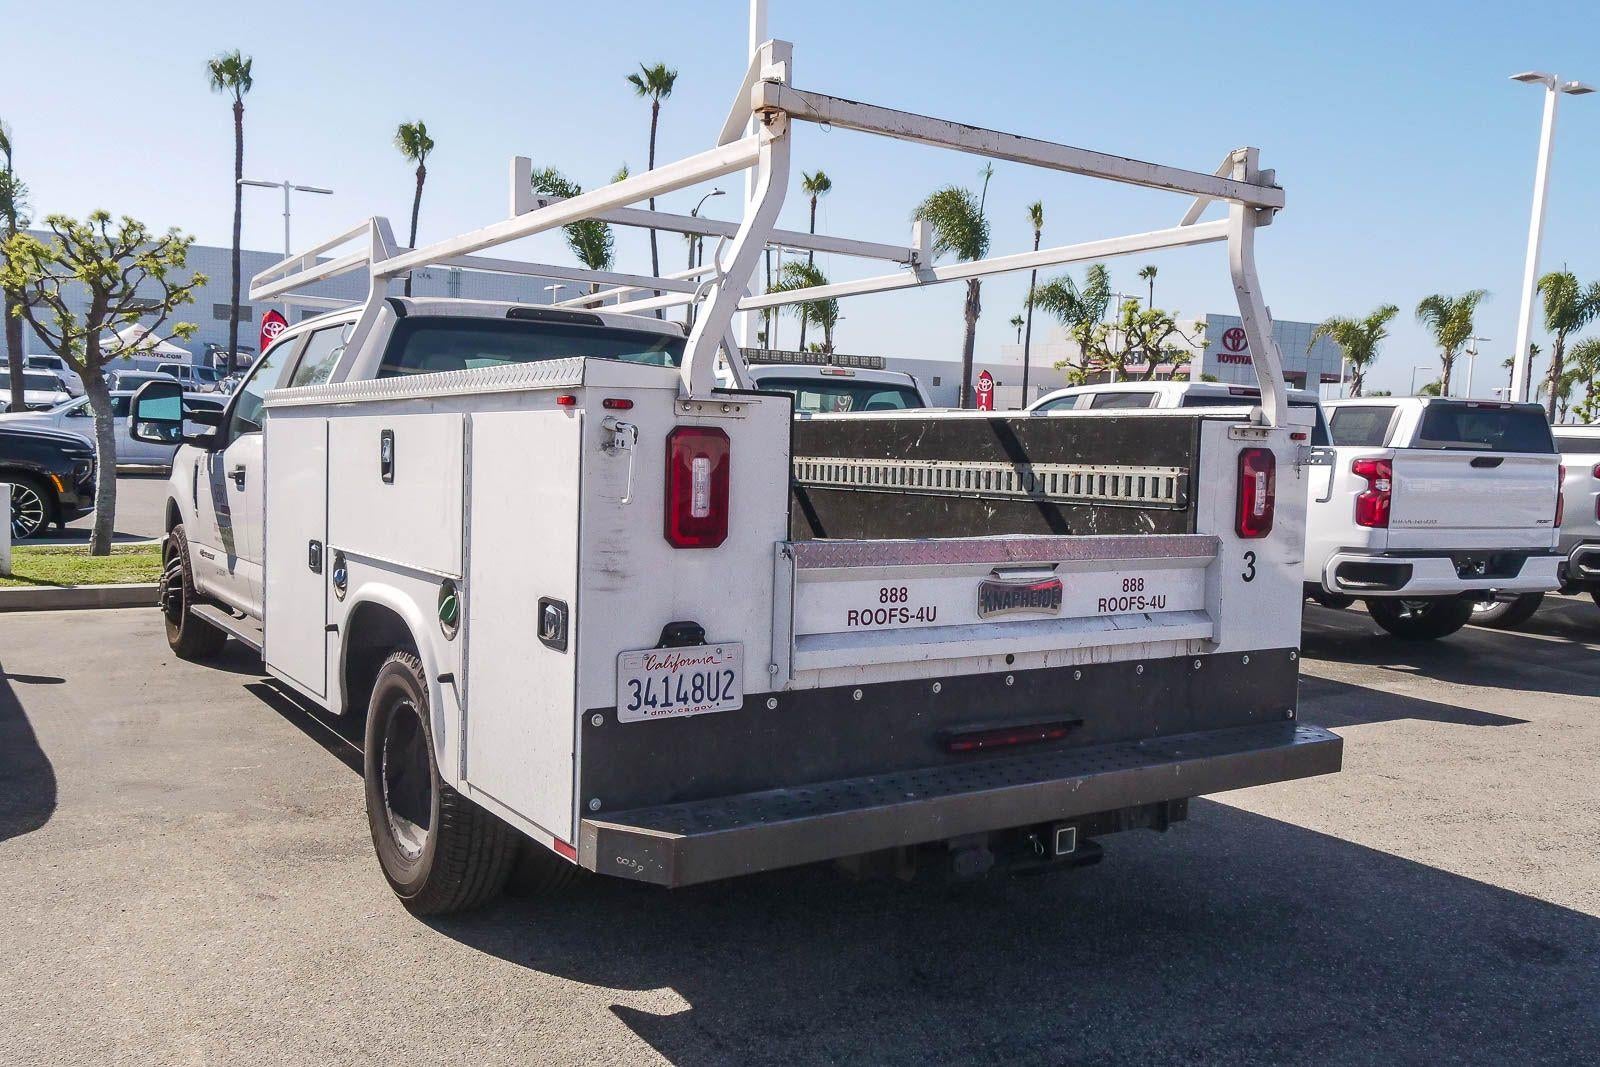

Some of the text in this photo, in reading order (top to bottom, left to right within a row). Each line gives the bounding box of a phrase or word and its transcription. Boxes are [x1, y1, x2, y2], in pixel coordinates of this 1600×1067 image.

[1241, 550, 1256, 582] 3
[879, 587, 908, 603] 888
[1122, 577, 1145, 593] 888
[983, 586, 1061, 613] KNAPHEIDE
[1098, 595, 1166, 613] ROOFS-4U
[847, 606, 937, 626] ROOFS-4U
[646, 653, 720, 673] California
[627, 670, 735, 711] 34148U2
[650, 704, 713, 716] dmv.ca.gov
